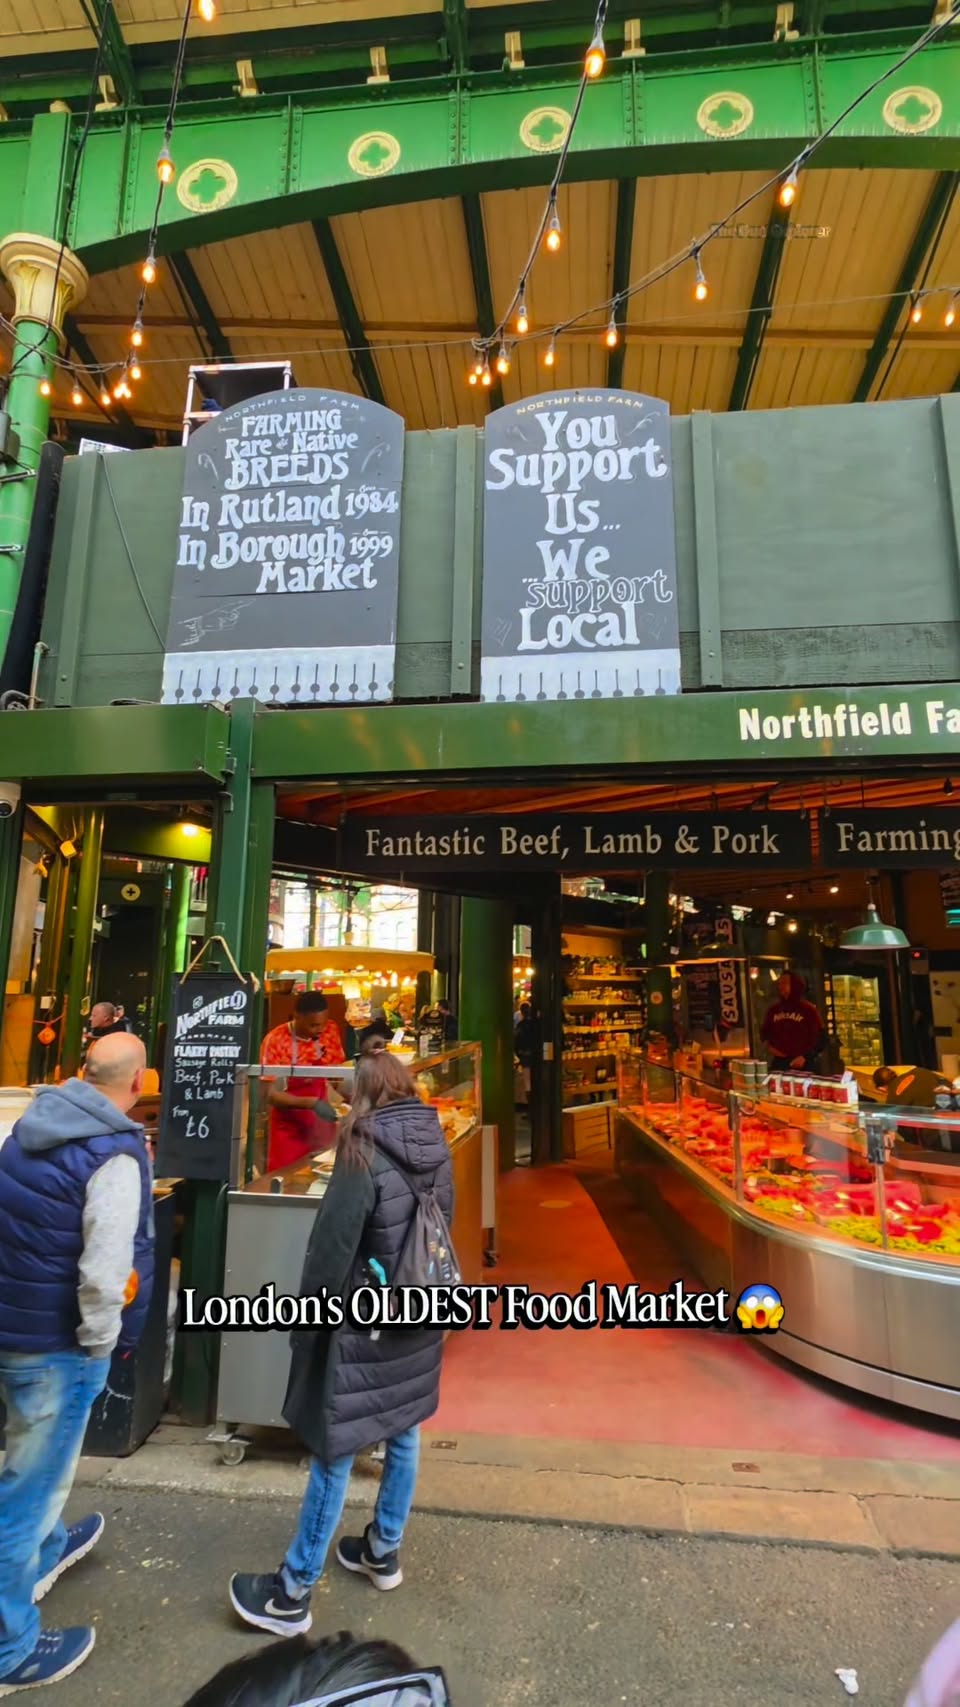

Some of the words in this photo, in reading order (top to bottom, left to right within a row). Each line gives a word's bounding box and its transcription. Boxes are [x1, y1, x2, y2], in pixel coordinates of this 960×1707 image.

[226, 395, 306, 423] NORTHFIELD
[319, 395, 360, 410] FARM
[241, 408, 343, 438] FARMING
[516, 395, 603, 415] NORTHFIELD
[224, 438, 272, 460] Rare
[291, 429, 359, 454] Native
[535, 411, 618, 451] You
[224, 451, 350, 491] BREEDS
[485, 437, 668, 493] Support
[180, 496, 210, 531] In
[217, 485, 341, 529] Rutland
[344, 490, 399, 520] 1984
[177, 533, 207, 570] In
[210, 525, 345, 570] Borough
[349, 535, 393, 559] 1999
[256, 556, 378, 594] Market
[525, 568, 673, 614] support
[517, 600, 641, 650] Local
[738, 701, 912, 741] Northfield
[365, 826, 486, 857] Fantastic
[500, 824, 570, 860] Beef,
[584, 824, 662, 855] Lamb
[674, 824, 700, 855] &
[712, 823, 781, 855] Pork
[716, 919, 738, 1022] SAUSAS
[174, 990, 247, 1039] NORTHFIELD
[207, 1014, 245, 1026] FARM
[184, 1088, 193, 1100] &
[196, 1086, 224, 1100] Lamb
[209, 1069, 235, 1086] Pork
[185, 1116, 209, 1139] £6
